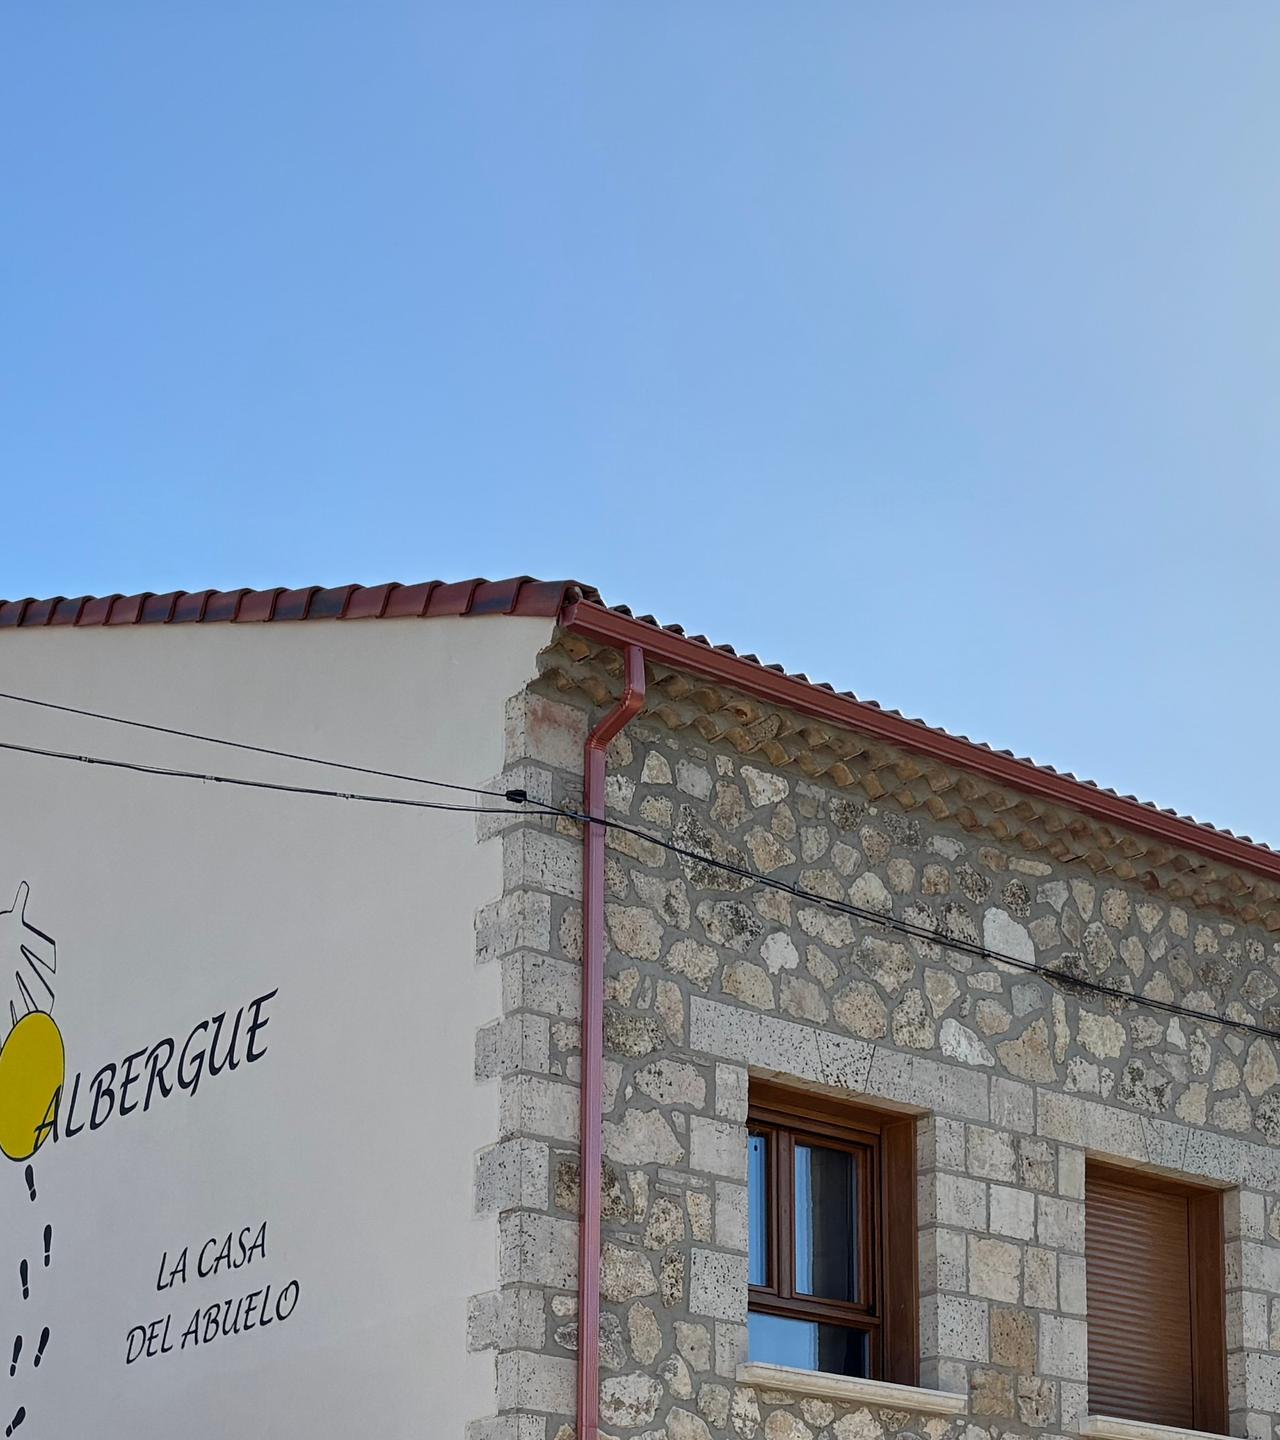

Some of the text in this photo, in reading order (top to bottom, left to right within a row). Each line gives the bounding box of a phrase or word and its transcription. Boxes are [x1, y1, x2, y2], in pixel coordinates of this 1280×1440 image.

[32, 987, 280, 1155] ALBERGUE
[156, 1220, 267, 1292] LA CASA
[125, 1279, 300, 1365] DEL ABUELO
